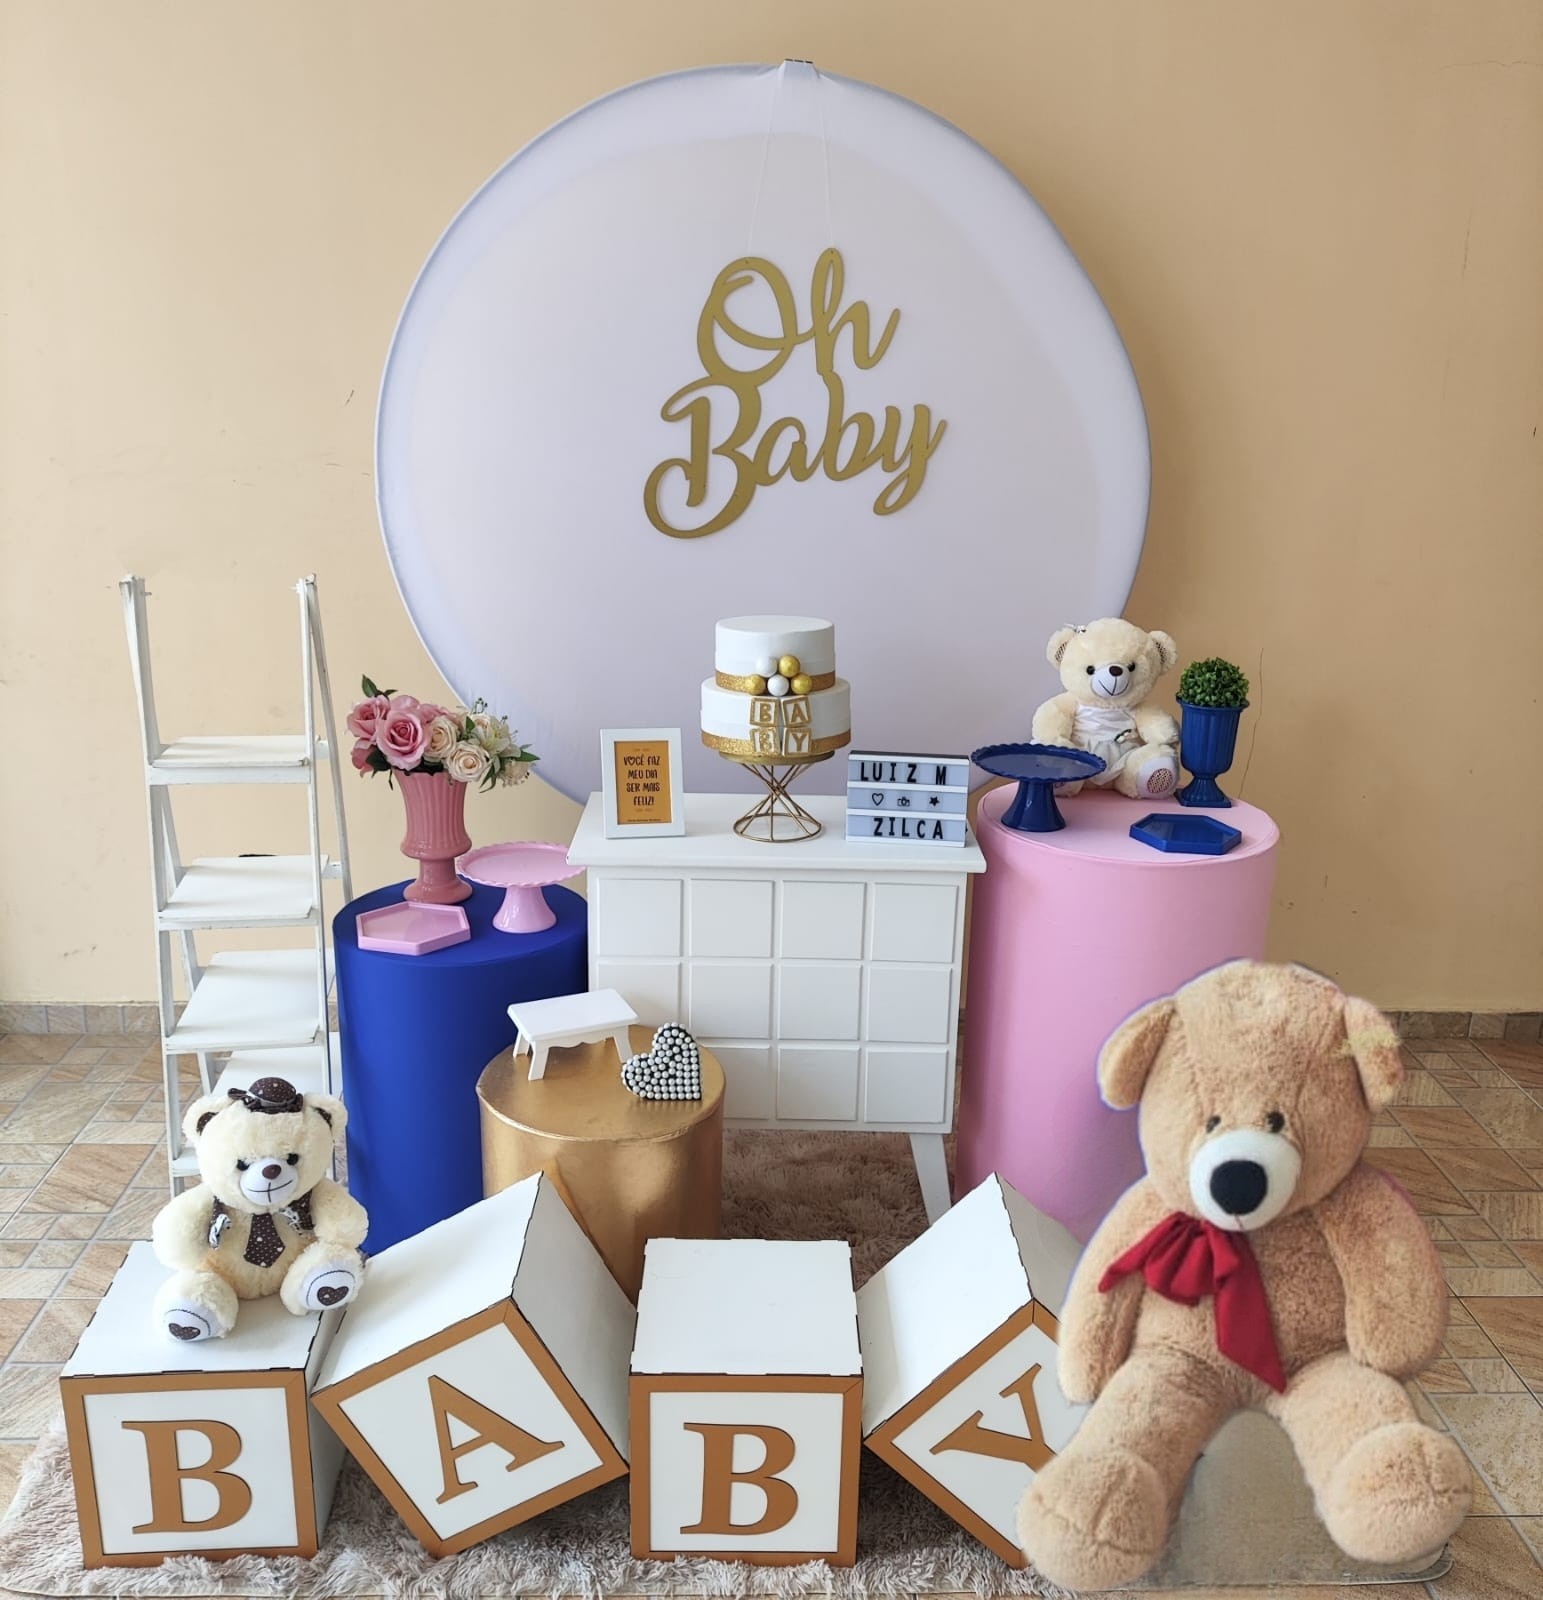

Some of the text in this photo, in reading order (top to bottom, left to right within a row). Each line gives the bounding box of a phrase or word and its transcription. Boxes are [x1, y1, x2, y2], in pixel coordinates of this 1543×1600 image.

[697, 248, 900, 382] Oh
[644, 371, 947, 538] Baby
[647, 755, 660, 766] FAZ
[628, 769, 658, 779] MEU DIA
[860, 761, 947, 786] LUIZ M
[626, 782, 660, 792] SER MAIS
[633, 795, 654, 806] FELIZ!
[873, 816, 944, 840] ZILCA
